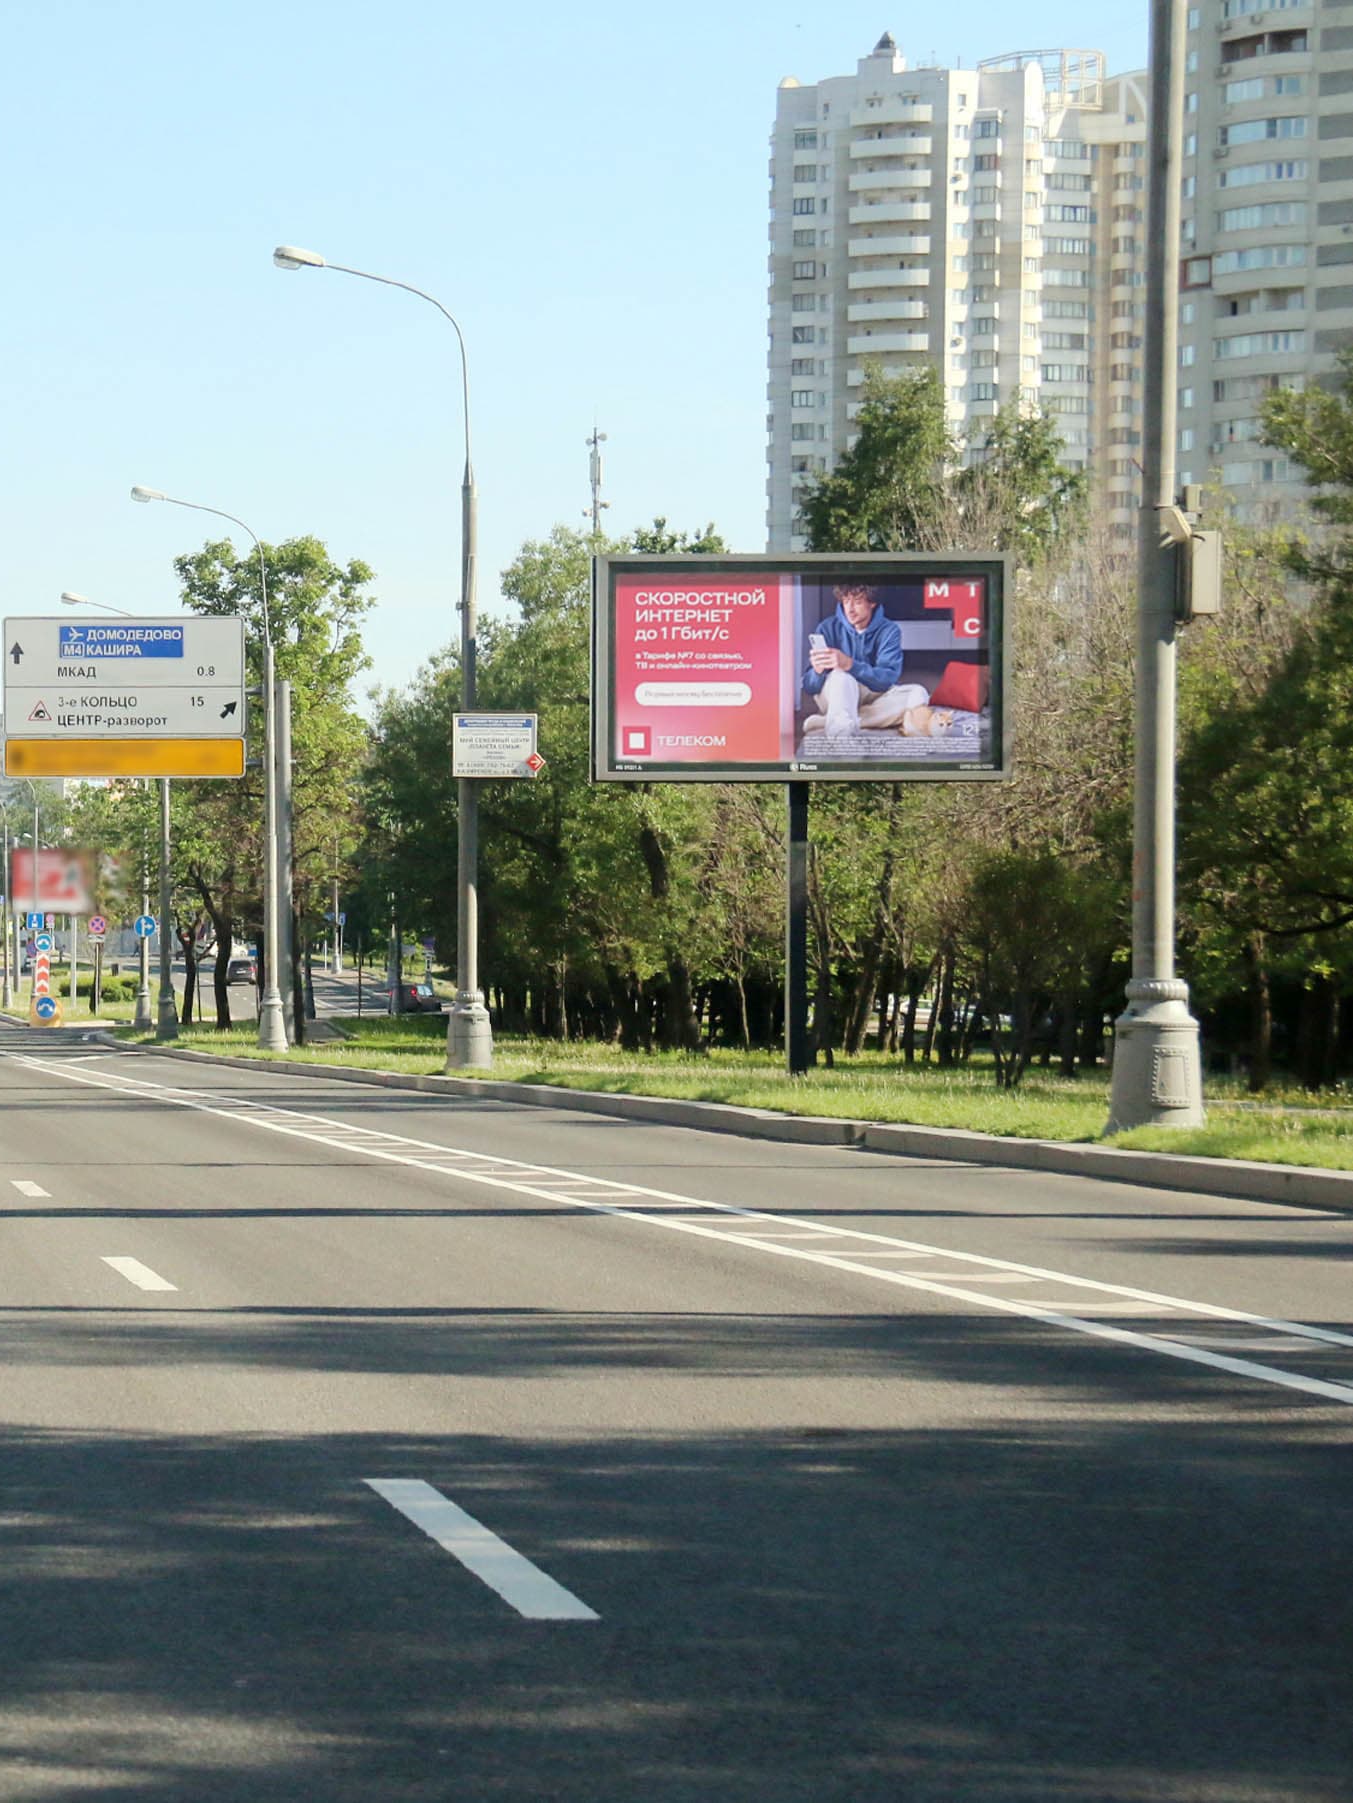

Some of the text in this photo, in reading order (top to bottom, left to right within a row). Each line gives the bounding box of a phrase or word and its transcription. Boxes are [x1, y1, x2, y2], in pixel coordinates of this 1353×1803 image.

[635, 589, 766, 605] СКОРОСТНОЙ
[635, 609, 733, 622] ИНТЕРНЕТ
[86, 629, 182, 642] ДОМОДЕДОВО
[634, 626, 729, 642] до 1 Гбит/с
[63, 643, 142, 656] М4 КАШИРА
[57, 666, 216, 679] МКАД 0.8
[57, 696, 205, 709] 3-е КОЛЬЦО 15
[57, 715, 168, 729] ЦЕНТР-разворот
[657, 735, 727, 747] ТЕЛЕКОМ
